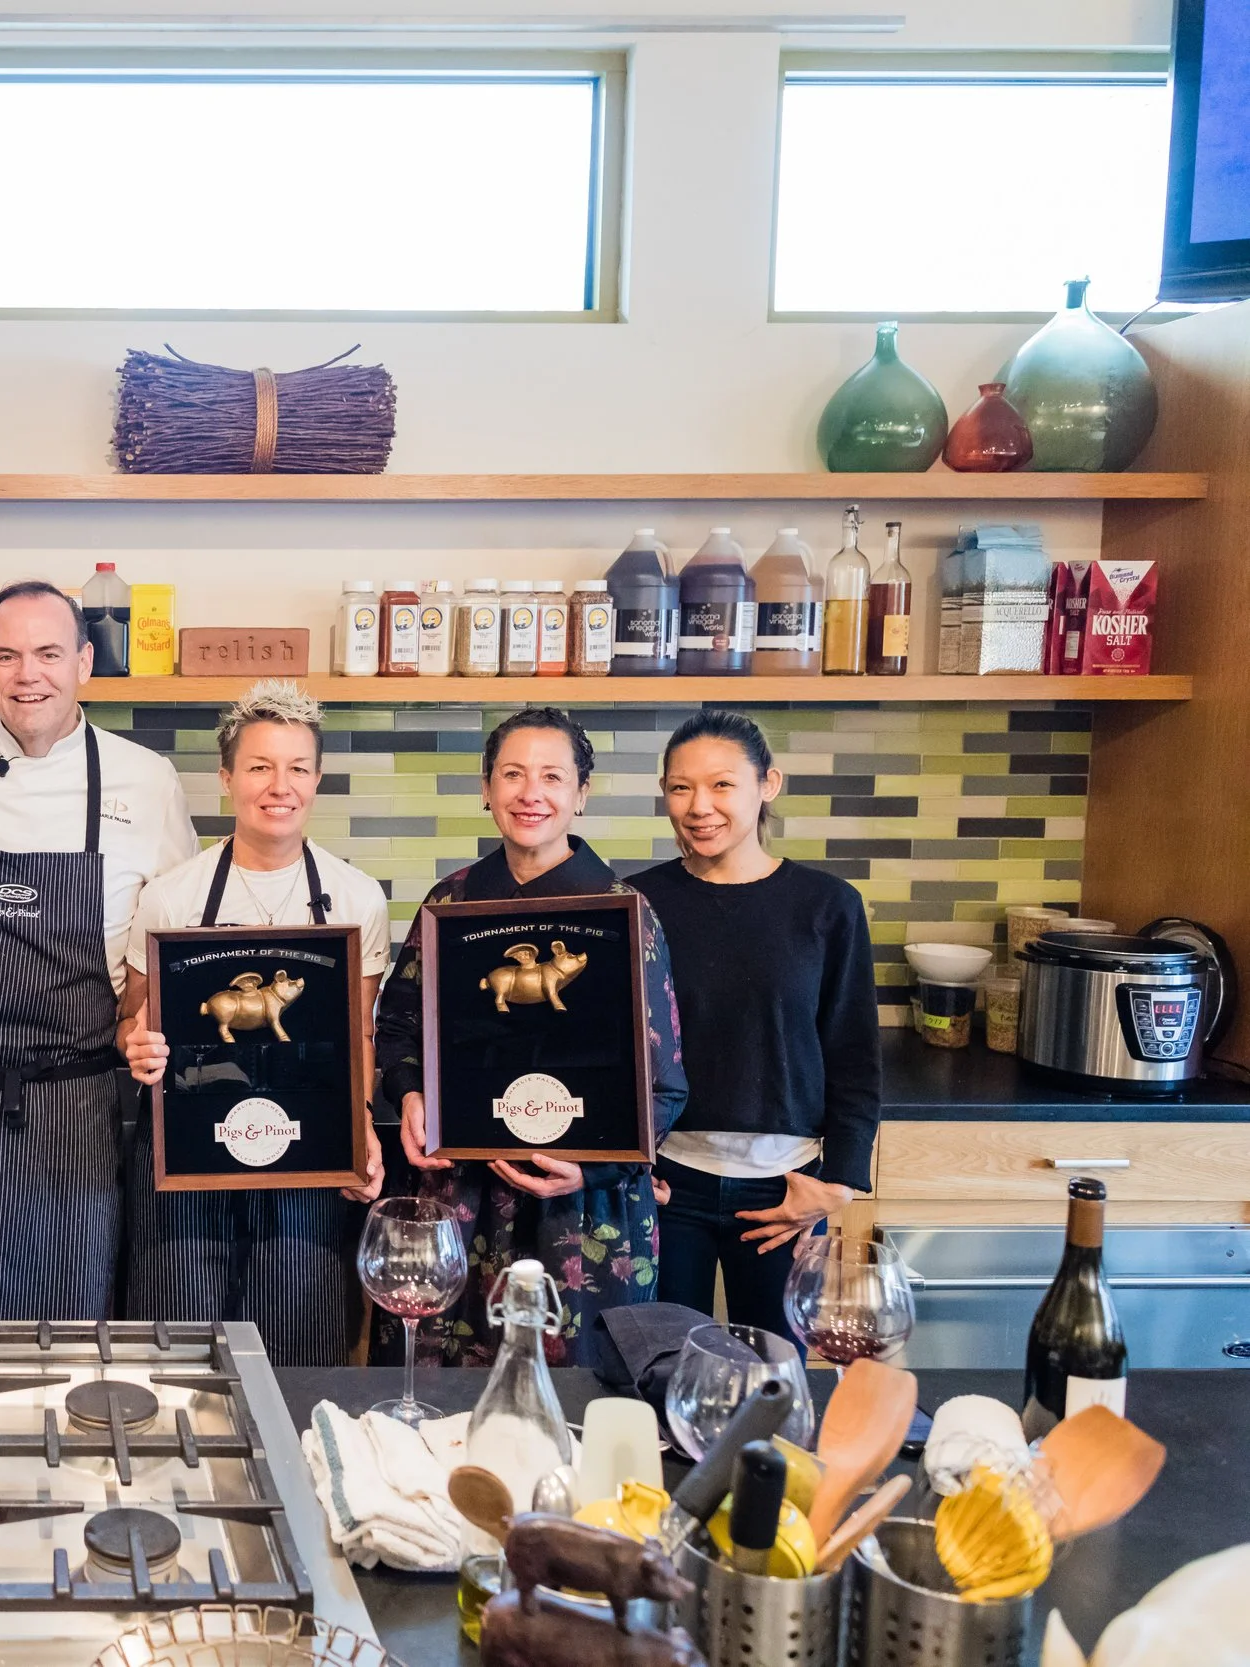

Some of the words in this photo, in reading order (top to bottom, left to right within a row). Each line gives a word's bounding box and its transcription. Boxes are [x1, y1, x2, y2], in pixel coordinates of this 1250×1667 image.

[995, 606, 1042, 616] ACQUERELLO
[137, 616, 171, 631] Colman's
[1092, 615, 1148, 635] KOSHER
[136, 638, 171, 651] Mustard
[199, 636, 294, 661] relish
[1106, 636, 1132, 646] SALT
[114, 816, 132, 825] PALMER
[0, 887, 32, 897] DCS
[462, 925, 535, 942] TOURNAMENT
[585, 928, 603, 937] PIG
[184, 950, 256, 966] TOURNAMENT
[304, 953, 322, 962] PIG
[497, 1102, 522, 1117] Pigs
[524, 1100, 543, 1116] &
[545, 1101, 580, 1113] Pinot
[218, 1126, 243, 1141] Pigs
[245, 1124, 262, 1140] &
[265, 1125, 297, 1136] Pinot
